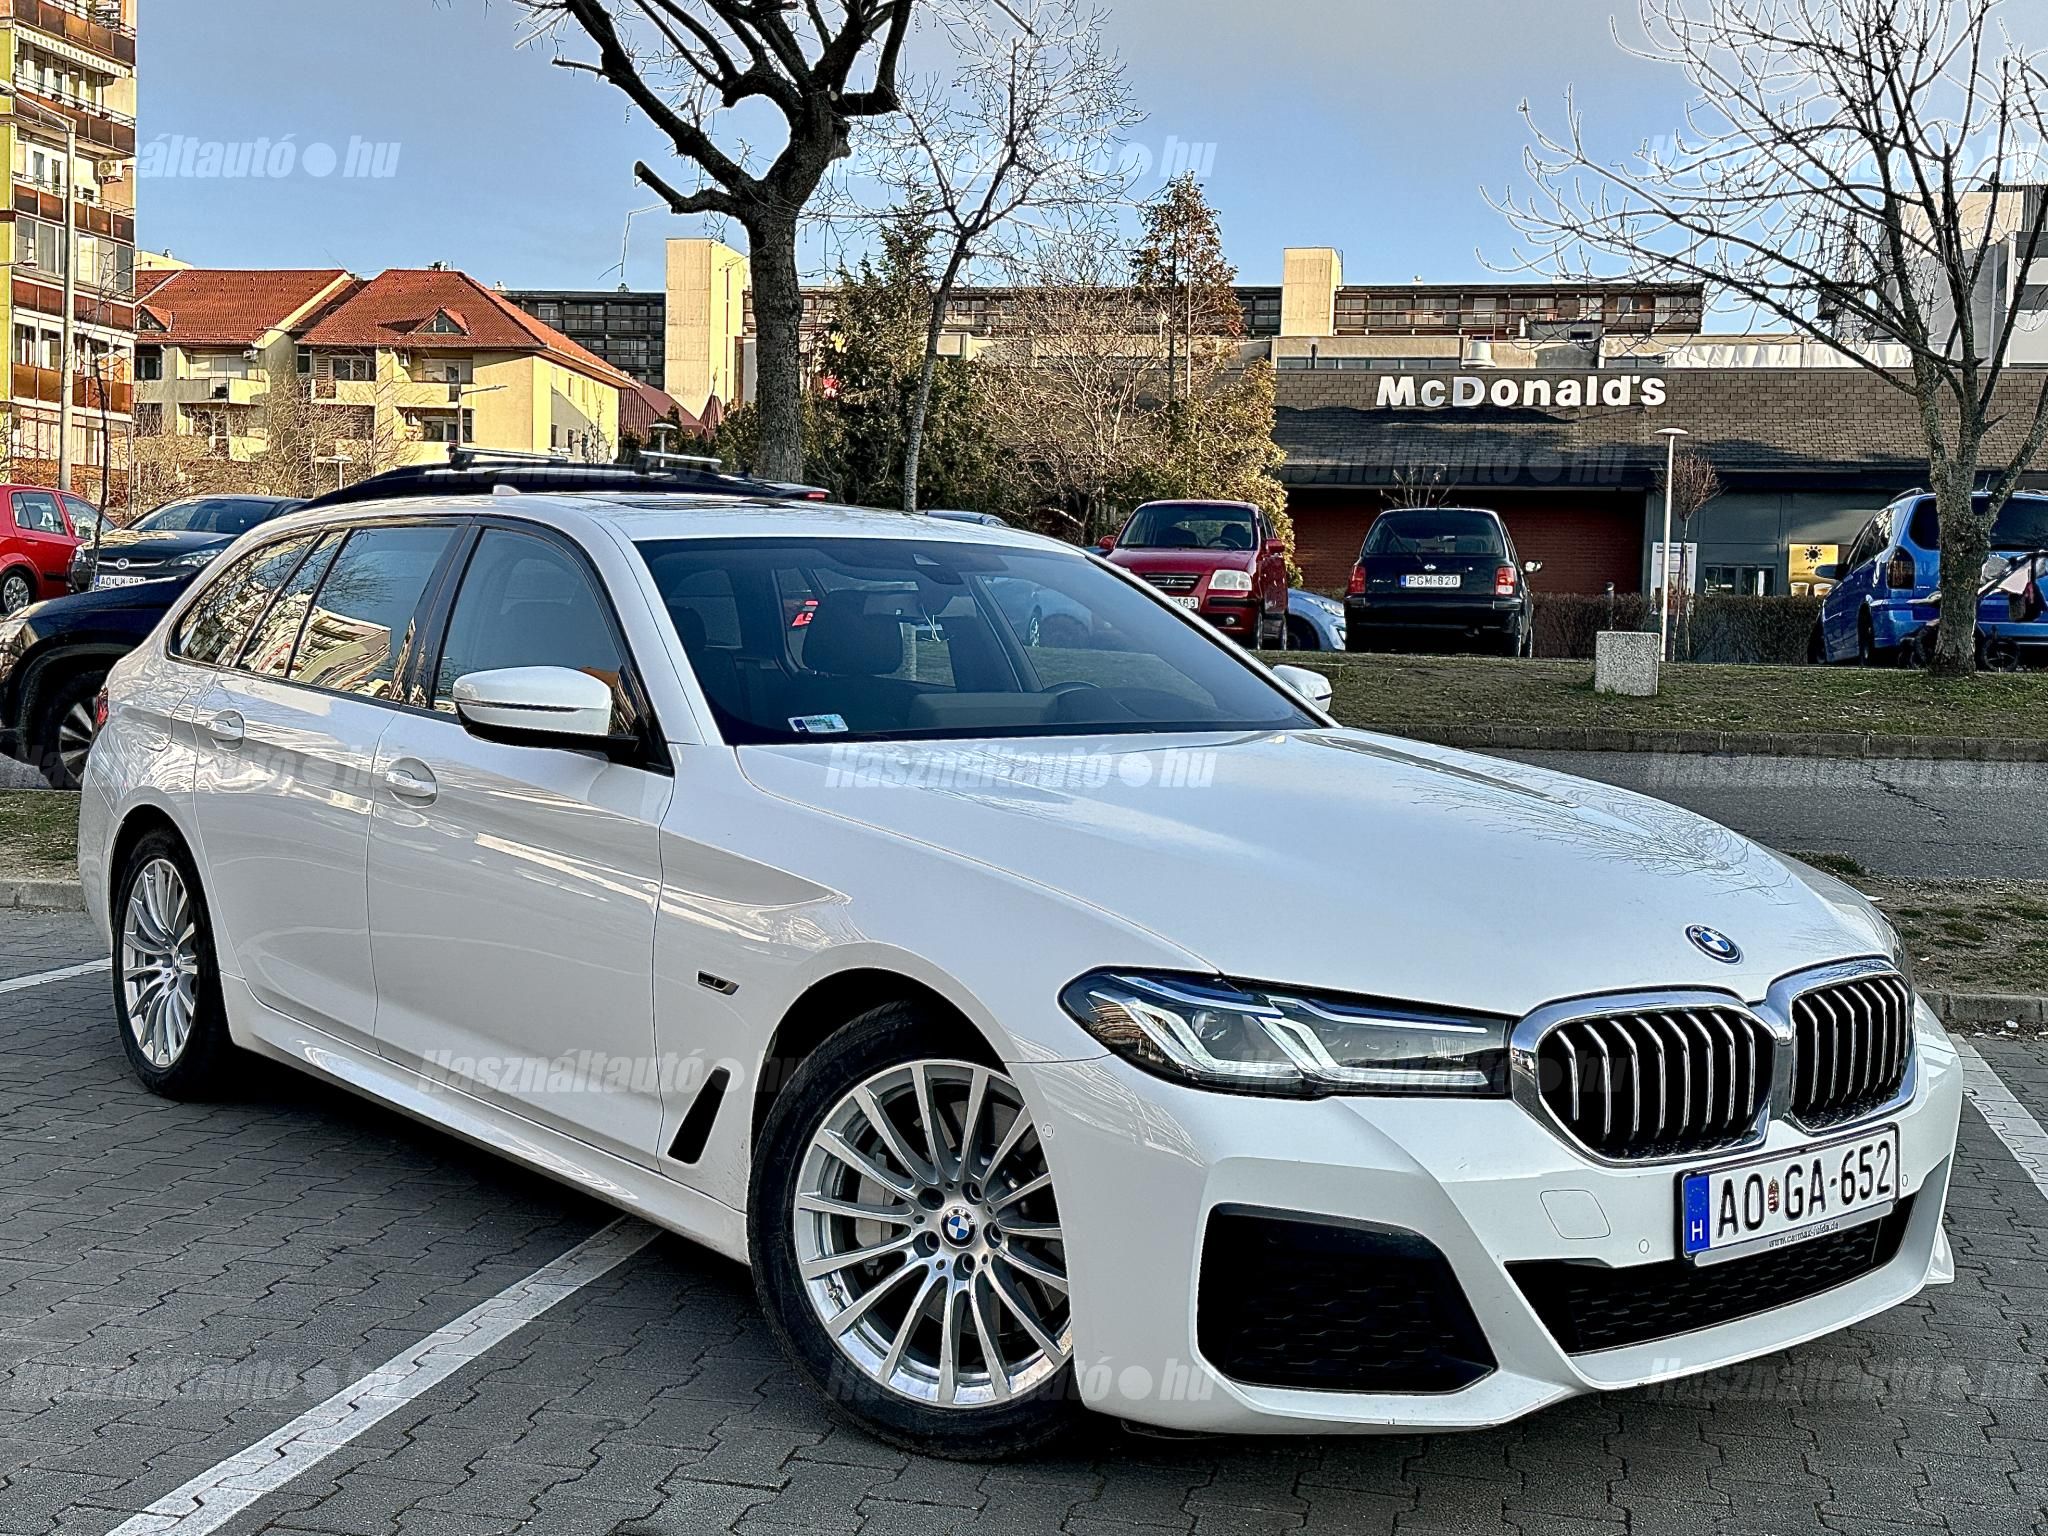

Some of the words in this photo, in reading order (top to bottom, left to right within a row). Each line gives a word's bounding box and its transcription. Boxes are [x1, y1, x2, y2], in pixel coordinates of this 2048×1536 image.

[1376, 375, 1667, 407] McDonald's
[1408, 576, 1458, 586] PGM-820
[1716, 1173, 1765, 1239] AO
[1784, 1139, 1891, 1221] GA-652
[1691, 1219, 1703, 1242] H
